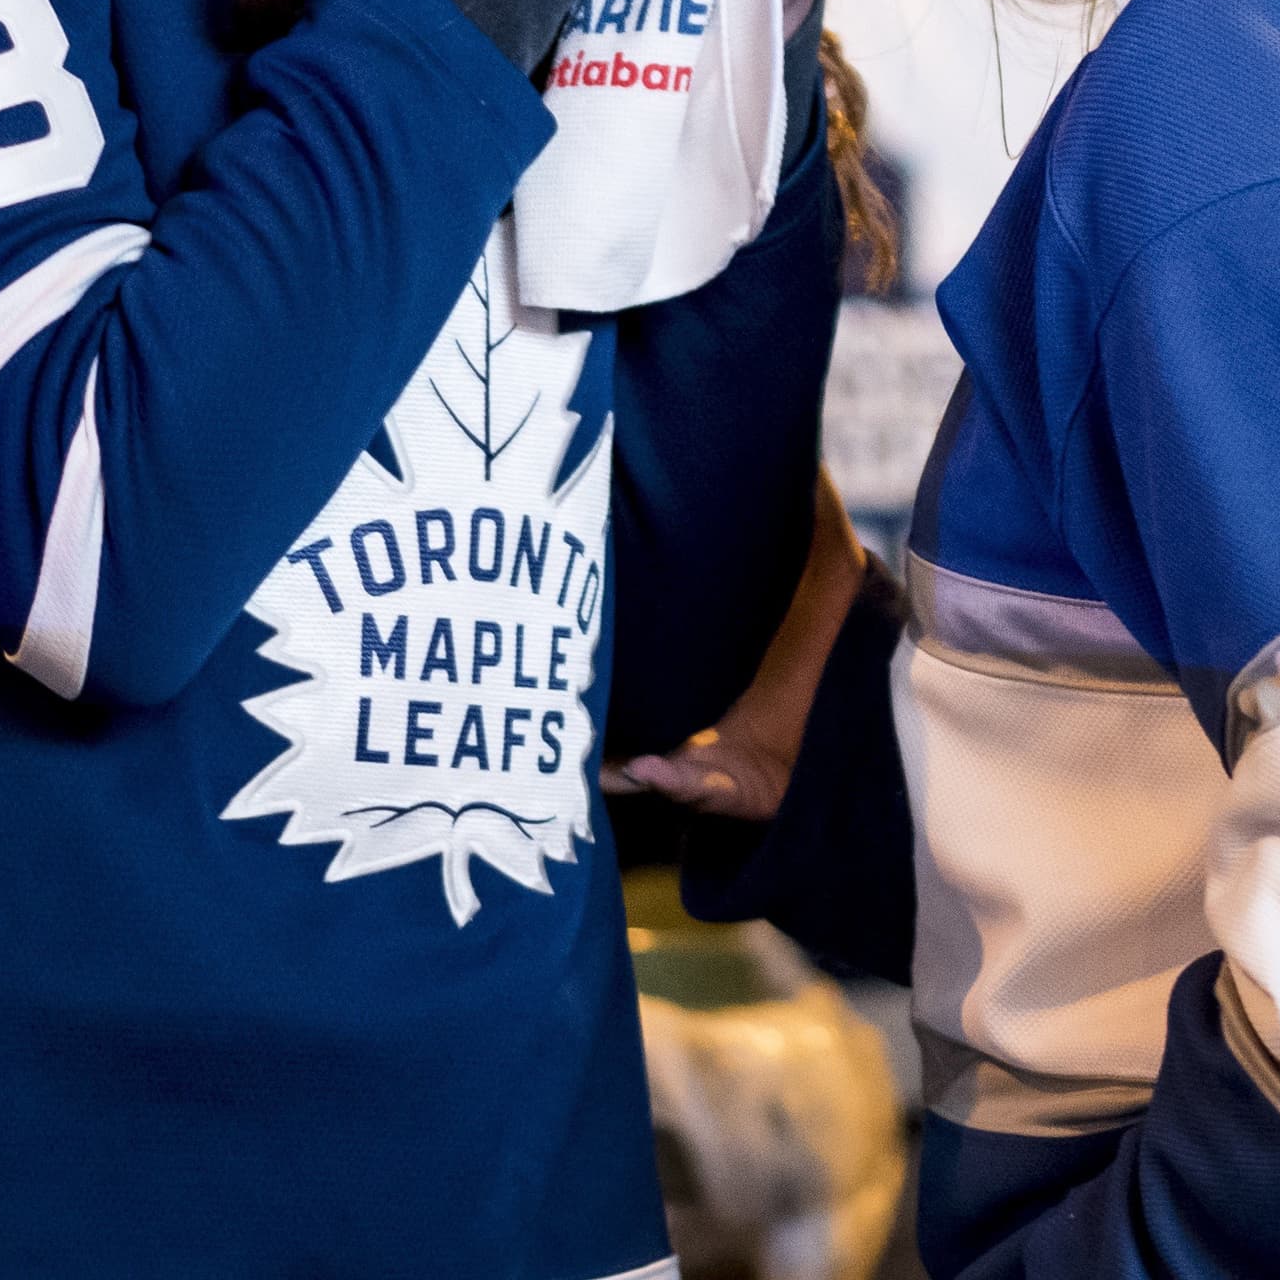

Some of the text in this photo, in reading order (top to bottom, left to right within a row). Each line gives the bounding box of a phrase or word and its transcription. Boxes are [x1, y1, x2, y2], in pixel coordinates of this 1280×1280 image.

[547, 49, 694, 93] tiaban
[285, 506, 600, 635] TORONTO
[359, 612, 572, 691] MAPLE
[354, 696, 566, 774] LEAFS
